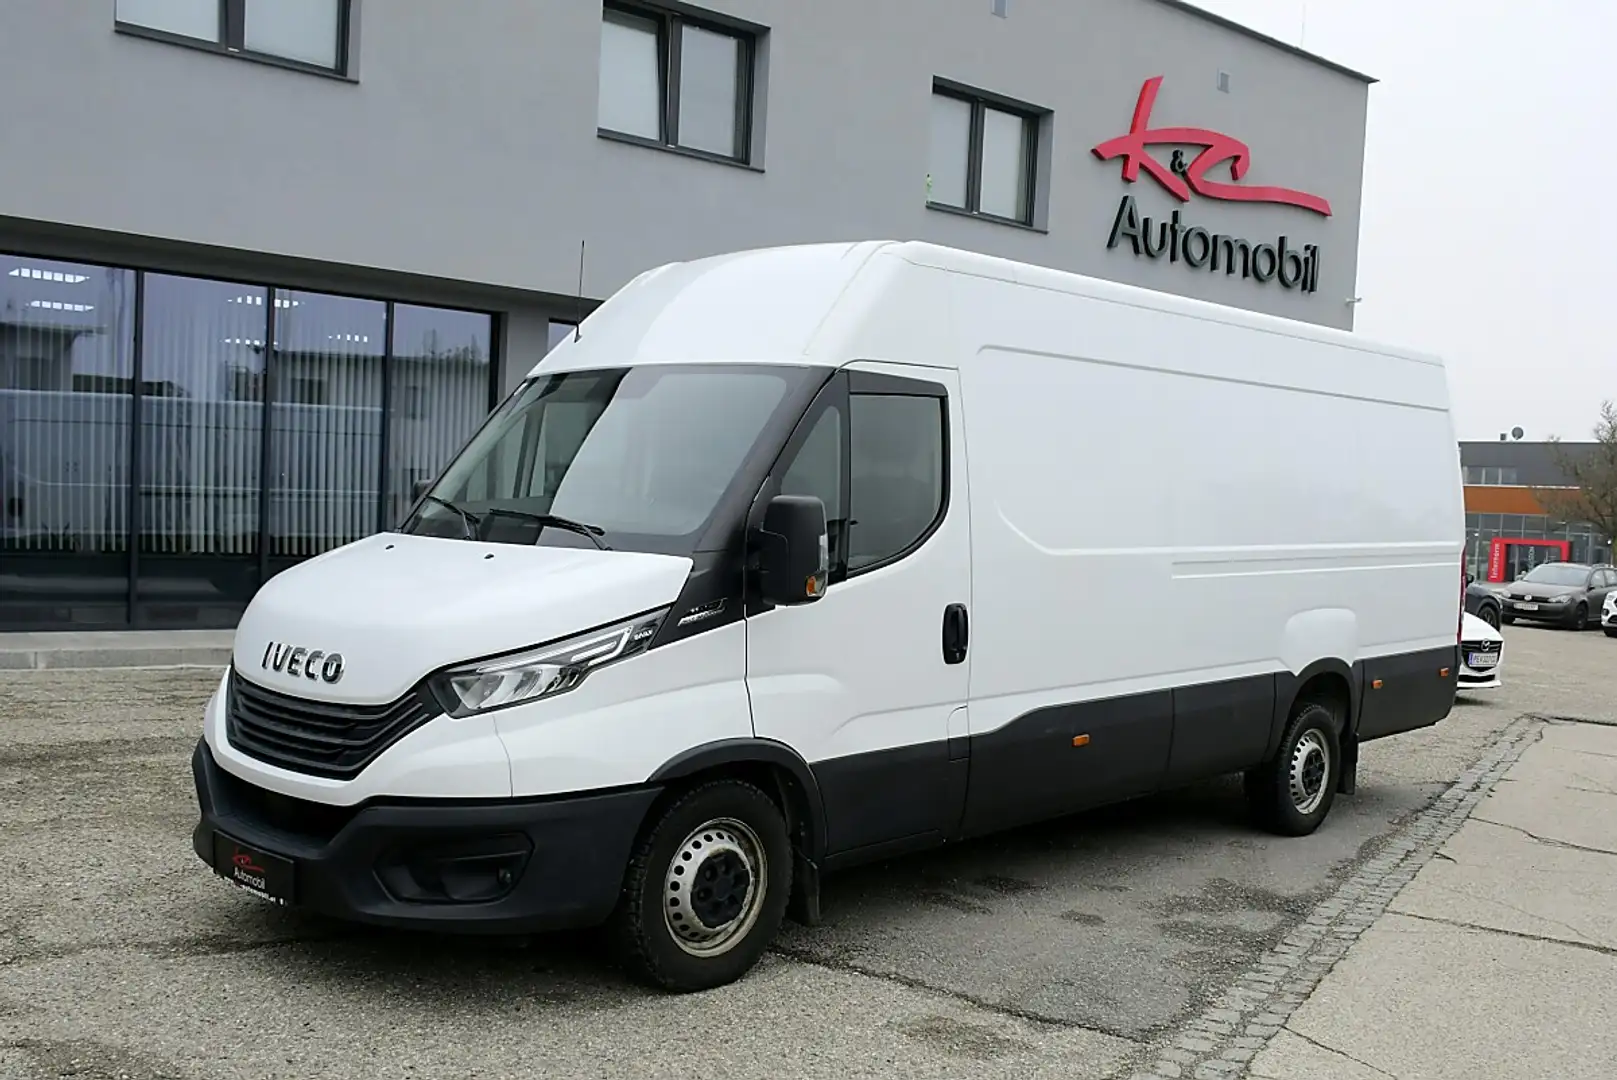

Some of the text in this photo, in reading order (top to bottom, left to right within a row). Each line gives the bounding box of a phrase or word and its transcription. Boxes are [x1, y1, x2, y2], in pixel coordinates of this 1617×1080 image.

[1106, 195, 1320, 293] Automobil
[261, 641, 345, 684] IVECO
[233, 866, 266, 890] Automobil
